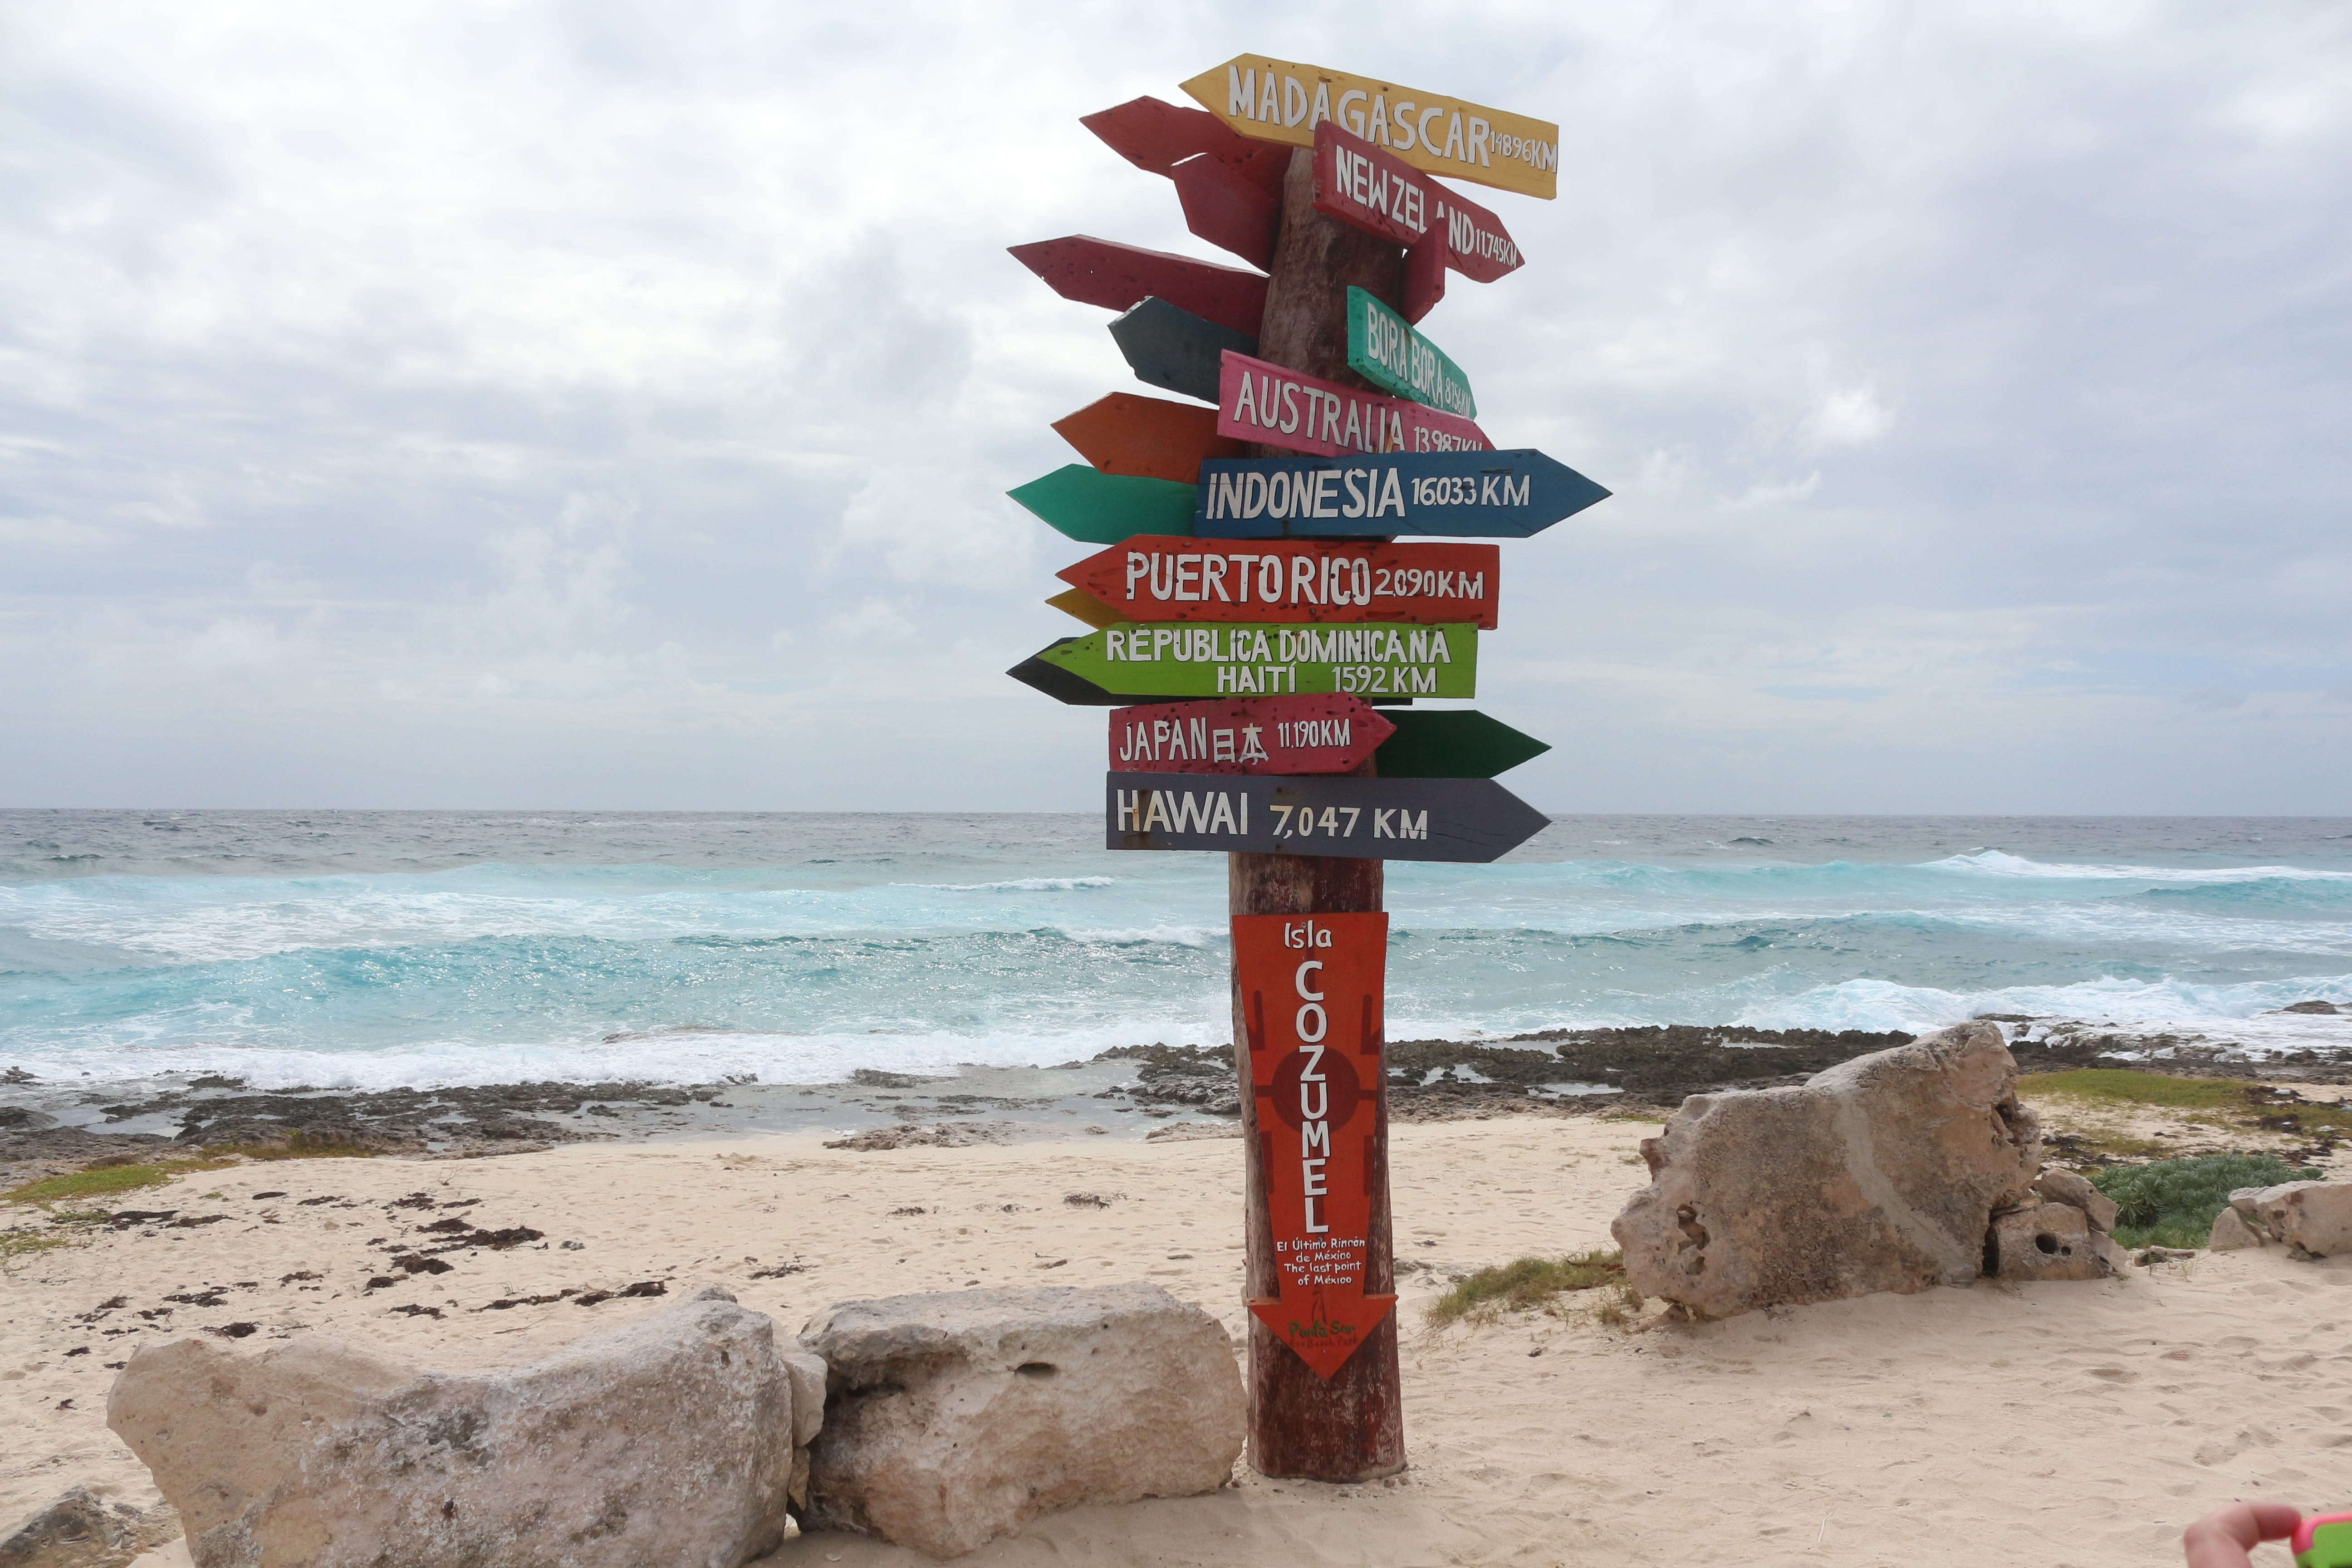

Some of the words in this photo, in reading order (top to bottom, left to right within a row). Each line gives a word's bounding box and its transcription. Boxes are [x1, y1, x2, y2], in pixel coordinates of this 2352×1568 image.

[1229, 65, 1490, 167] MADAGASCAR
[1490, 131, 1558, 173] 14896KM
[1367, 302, 1409, 381] BORA
[1411, 340, 1443, 408] BORA
[1233, 371, 1405, 453] AUSTRALIA
[1206, 468, 1406, 519] INDONESIA
[1481, 475, 1530, 506] KM
[1126, 552, 1283, 602] PUERTO
[1291, 556, 1371, 605] RICO
[1107, 629, 1273, 663] REPUBLICA
[1279, 629, 1451, 664] DOMINICANA
[1218, 661, 1296, 693] HAITÍ
[1332, 665, 1388, 693] 1592
[1393, 667, 1437, 693] KM
[1119, 717, 1207, 762] JAPAN
[1212, 722, 1269, 765] 日本
[1117, 789, 1248, 835] HAWAI
[1270, 804, 1362, 839] 7,047
[1374, 808, 1429, 840] KM
[1284, 920, 1332, 948] Isla
[1295, 960, 1330, 1233] COZUMEL
[1277, 1241, 1287, 1252] El
[1293, 1237, 1327, 1250] Último
[1331, 1236, 1365, 1249] Rincón
[1284, 1263, 1305, 1273] The
[1310, 1262, 1332, 1273] last
[1335, 1261, 1362, 1274] point
[1296, 1252, 1310, 1263] de
[1315, 1250, 1351, 1262] México
[1298, 1274, 1310, 1286] of
[1314, 1275, 1352, 1284] México
